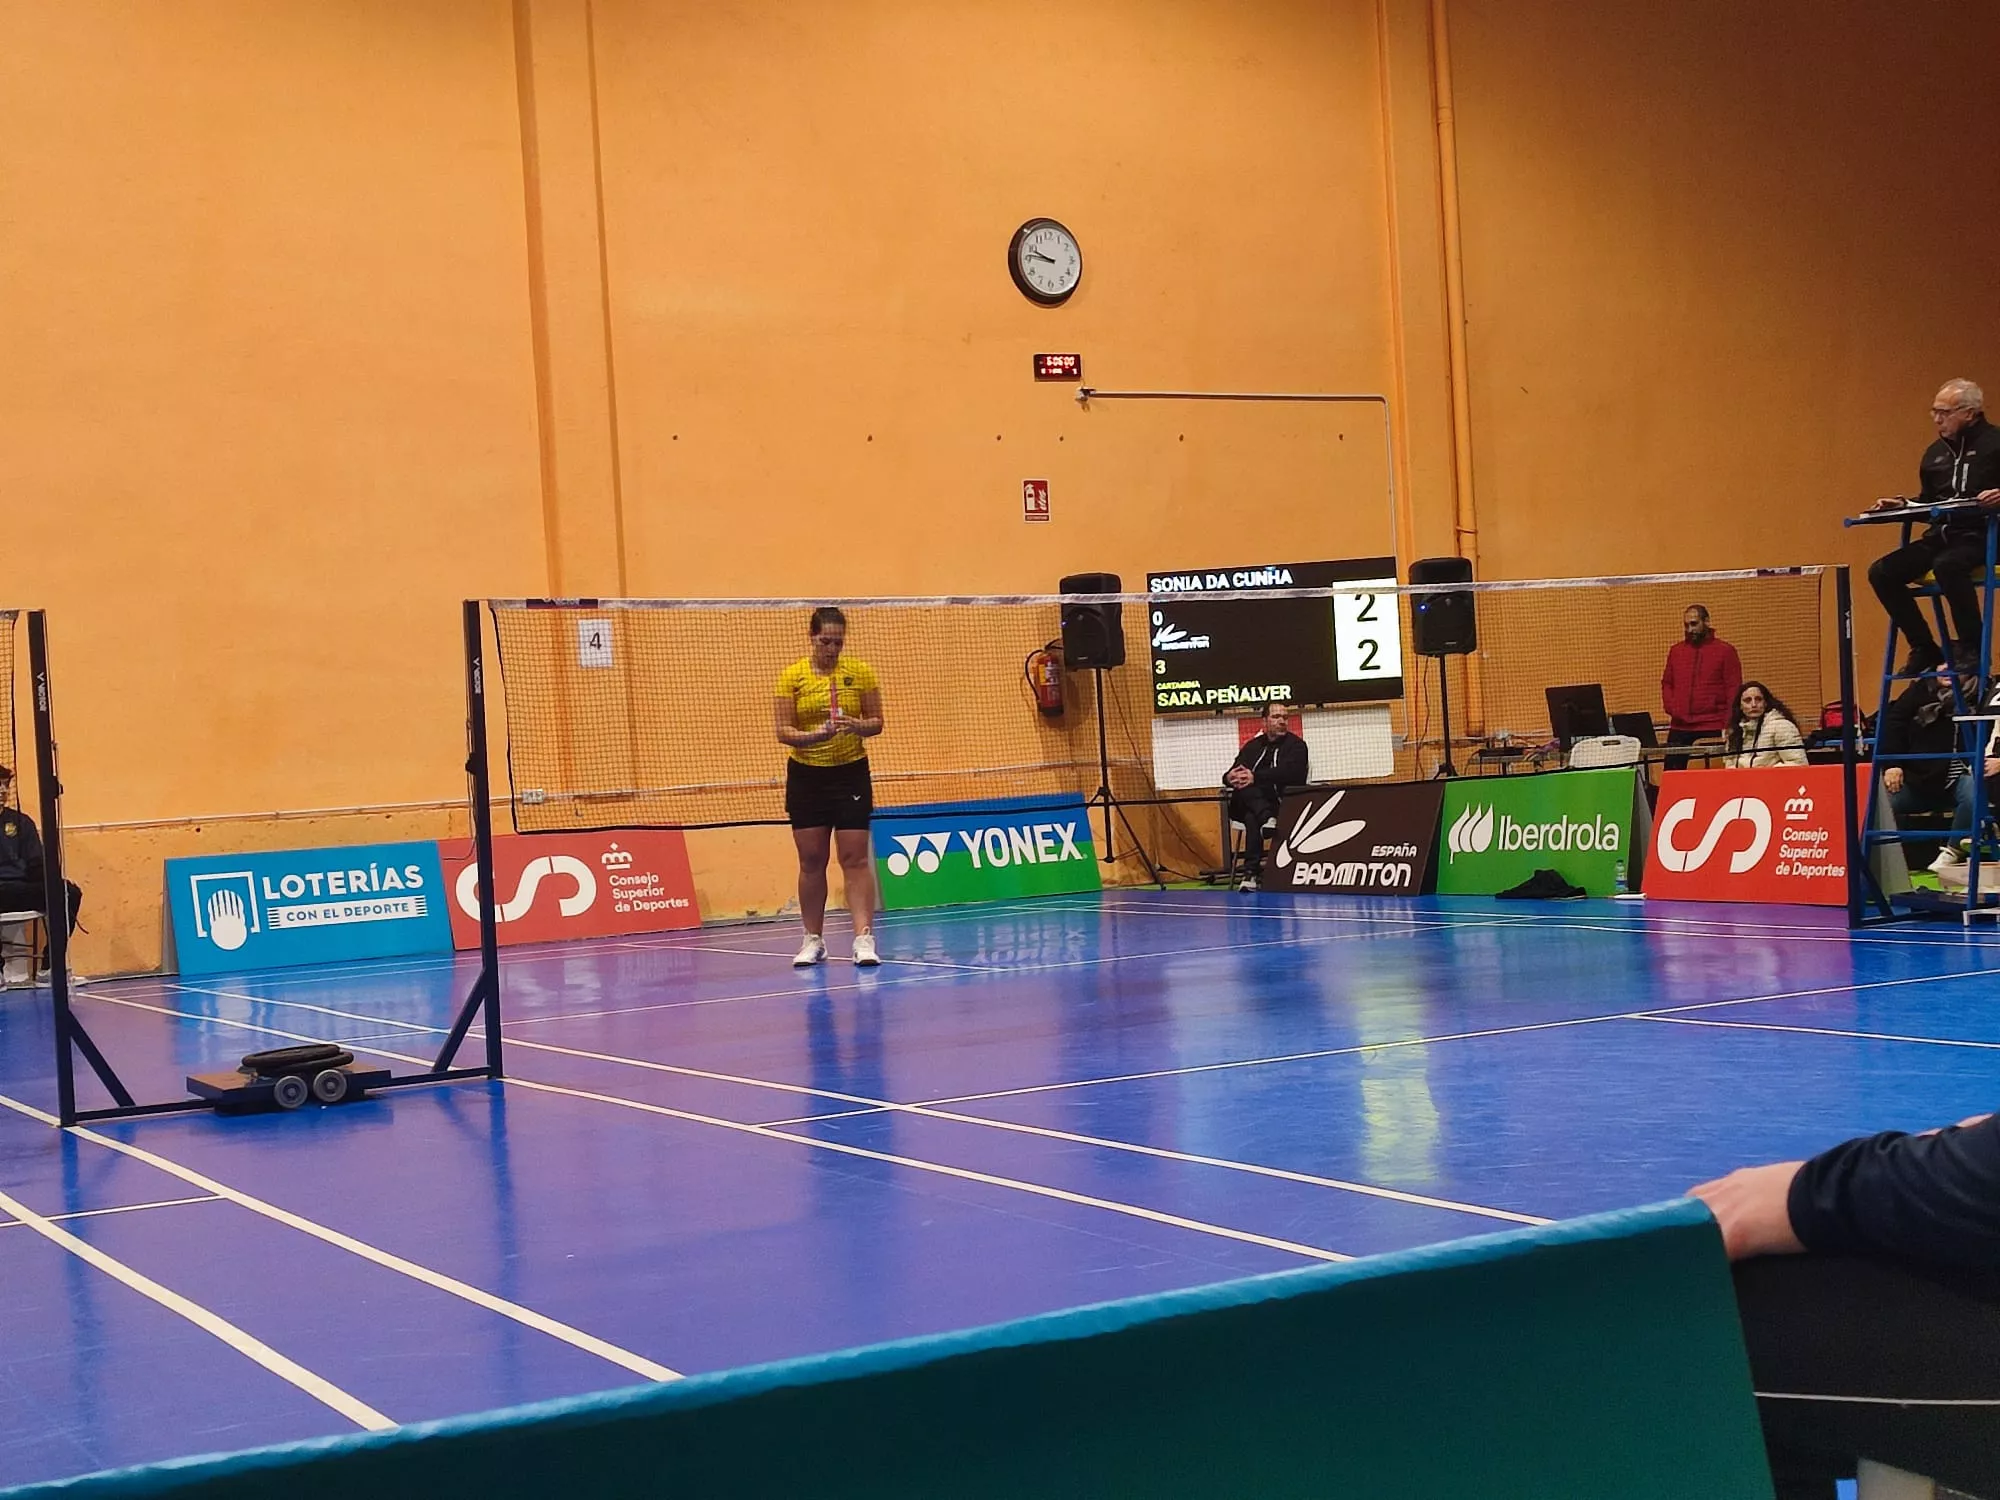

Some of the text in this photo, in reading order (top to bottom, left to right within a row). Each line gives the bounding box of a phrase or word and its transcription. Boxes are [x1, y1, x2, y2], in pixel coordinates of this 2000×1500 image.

[1150, 569, 1293, 593] SONIA DA CUNHA
[1355, 594, 1378, 622] 2
[589, 632, 602, 650] 4
[1357, 638, 1381, 670] 2
[1155, 660, 1167, 675] 3
[1157, 684, 1291, 707] SARA PEÑALVER
[1498, 814, 1620, 851] Iberdrola
[1782, 827, 1829, 848] Consejo
[958, 822, 1083, 869] YONEX
[1371, 842, 1417, 857] ESPAÑA
[1779, 844, 1829, 862] Superior
[1292, 862, 1412, 887] BADMINTON
[1775, 860, 1846, 879] de Deportes
[263, 863, 424, 900] LOTERÍAS
[609, 872, 659, 893] Consejo
[612, 885, 665, 903] Superior
[286, 902, 409, 922] CON EL DEPORTE
[615, 897, 689, 913] de Deportes
